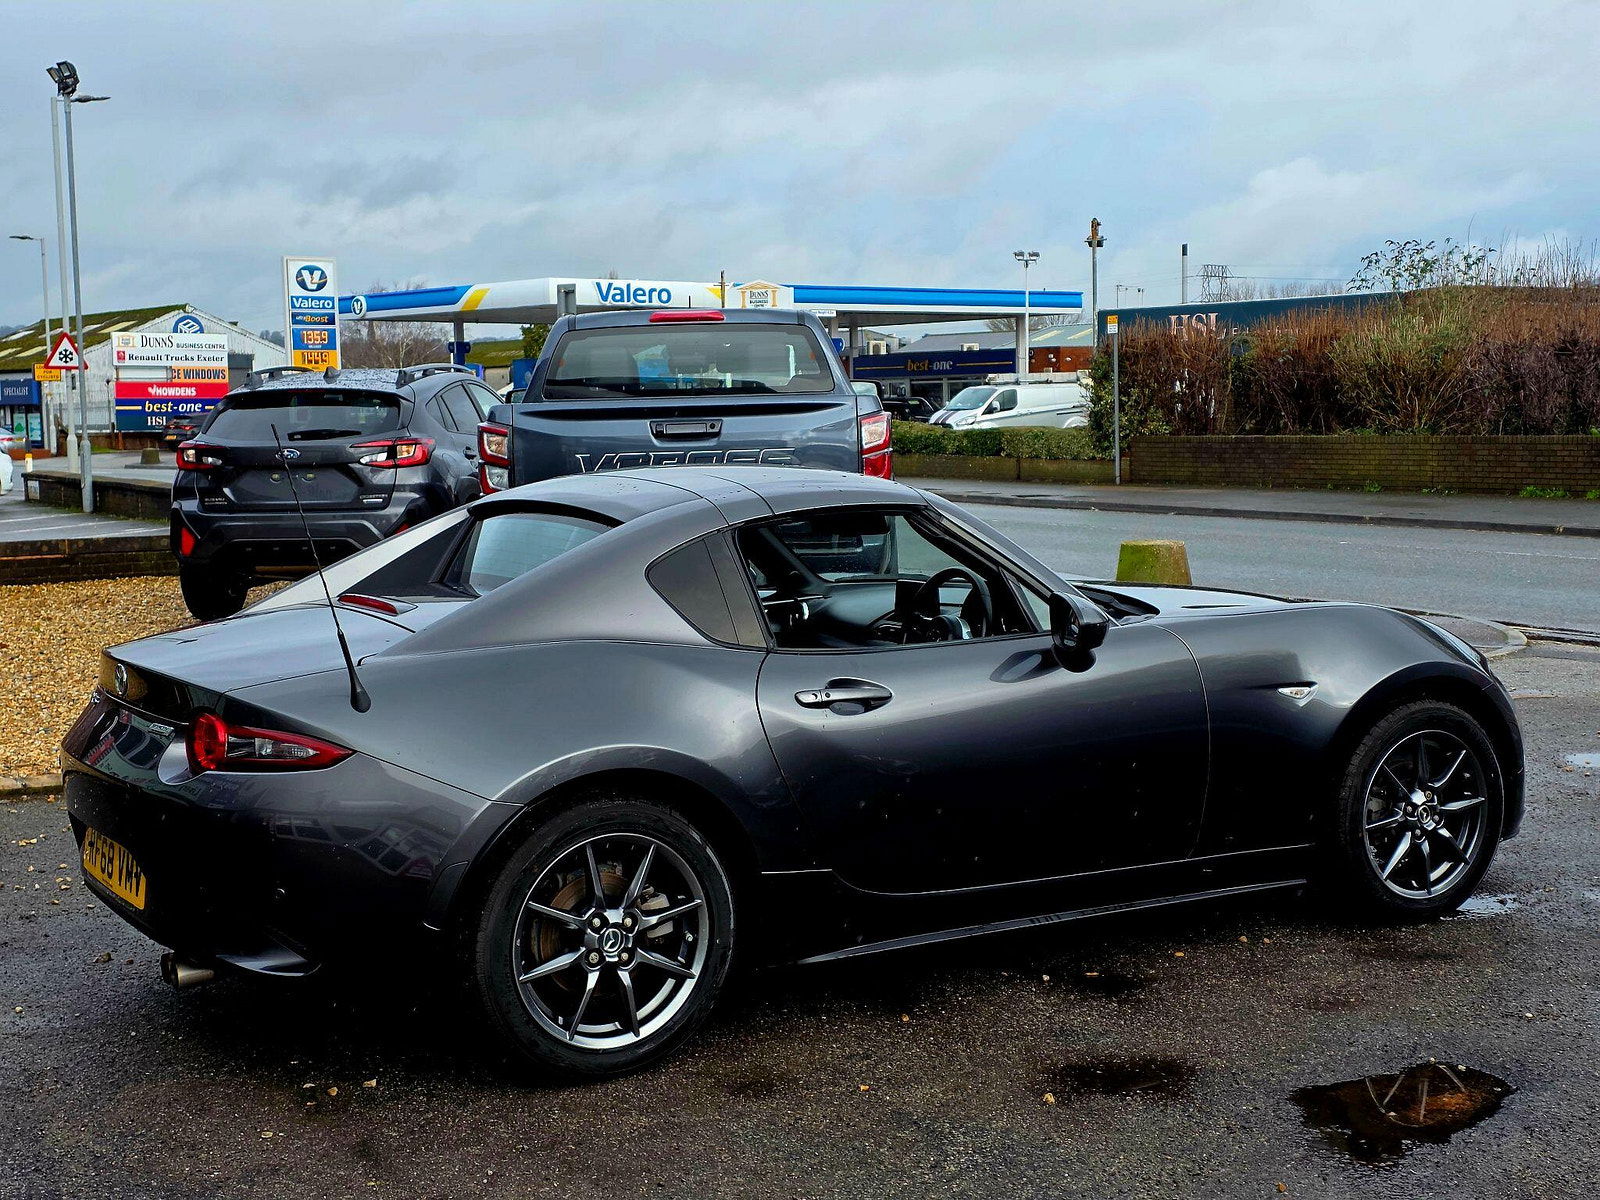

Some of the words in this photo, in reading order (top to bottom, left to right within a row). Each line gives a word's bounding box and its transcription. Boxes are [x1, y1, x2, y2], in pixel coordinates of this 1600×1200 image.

[595, 281, 672, 304] Valero
[292, 297, 333, 308] Valero
[1169, 312, 1225, 340] HSL
[141, 334, 174, 349] DUNNS
[128, 353, 162, 361] Renault
[164, 353, 195, 362] Trucks
[197, 354, 225, 362] Exeter
[905, 359, 953, 372] best-one
[183, 368, 226, 380] WINDOWS
[3, 386, 29, 396] SPECIALIST
[156, 386, 197, 397] HOWDENS
[145, 400, 203, 412] best-one
